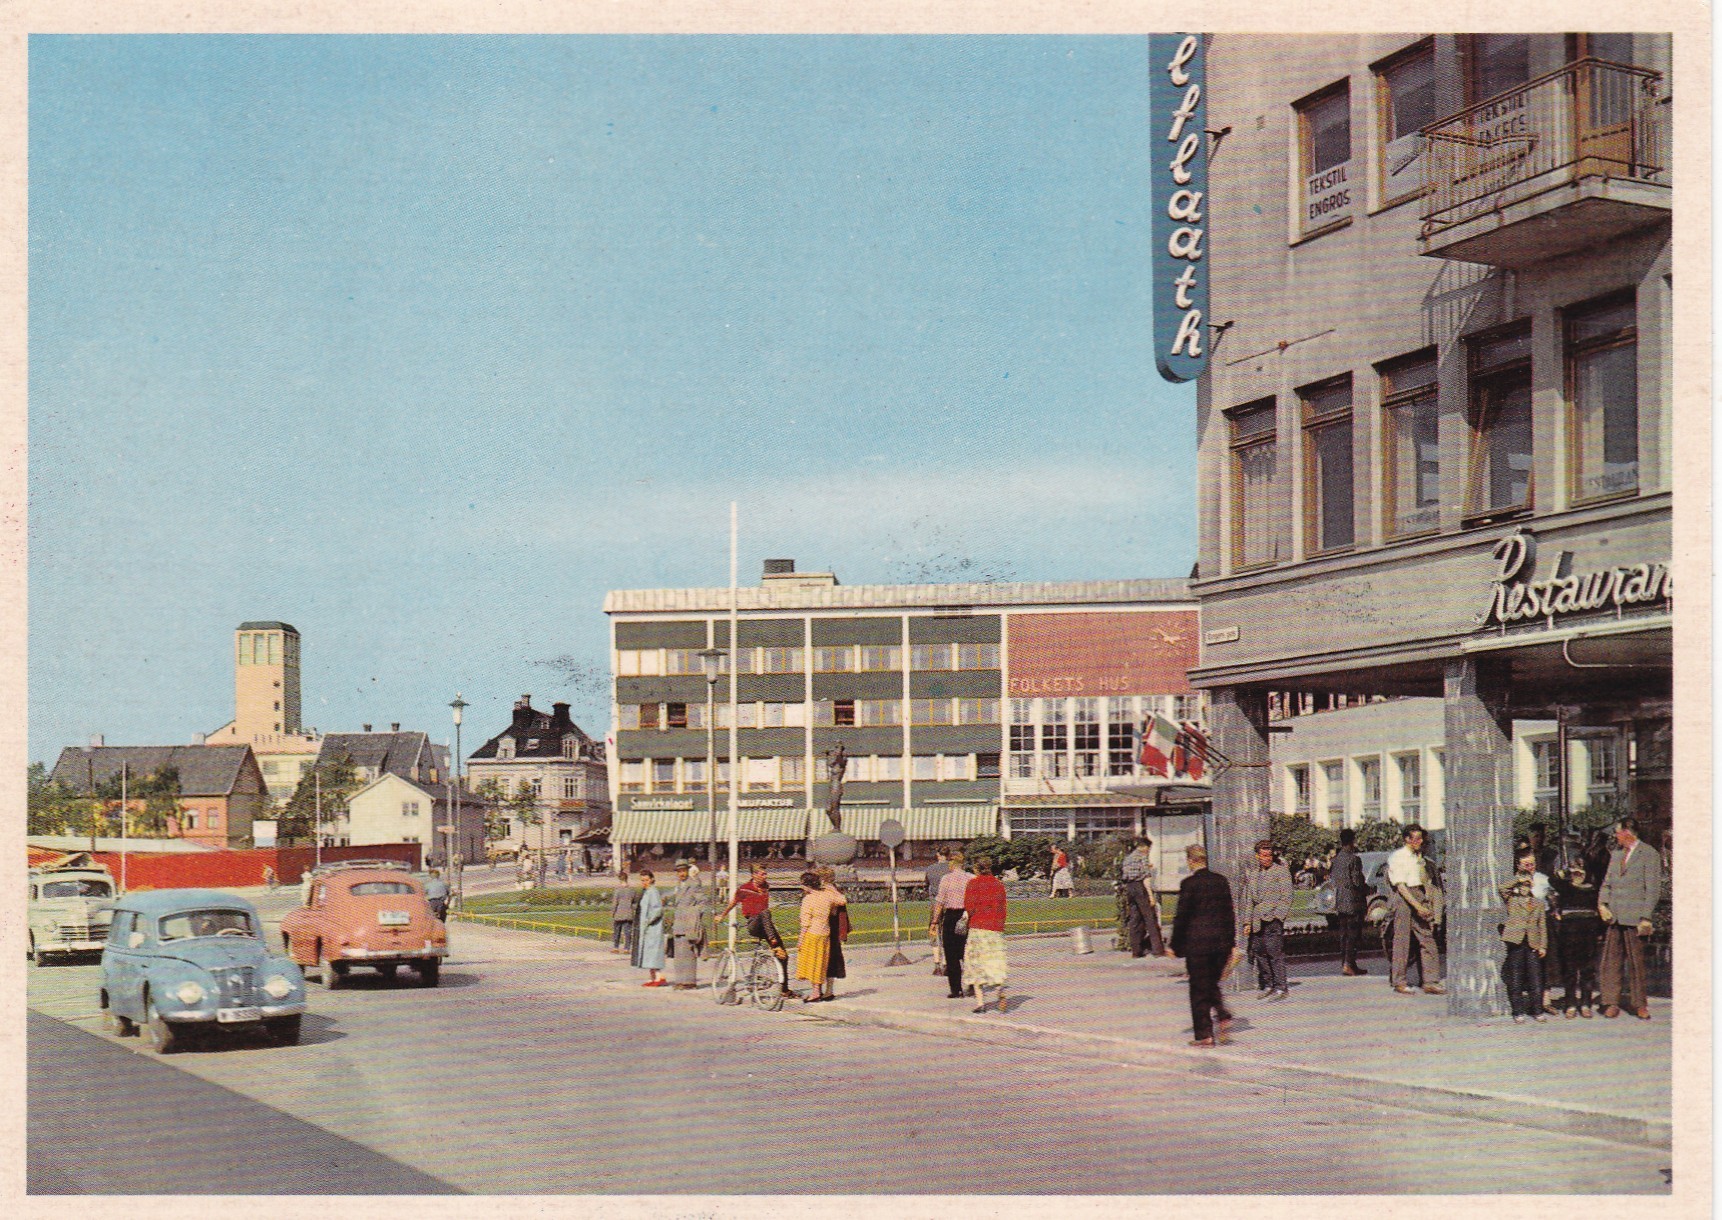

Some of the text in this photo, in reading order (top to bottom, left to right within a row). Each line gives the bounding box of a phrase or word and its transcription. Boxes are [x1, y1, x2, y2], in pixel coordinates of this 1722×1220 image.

[1309, 166, 1347, 195] TEKSTIL
[1309, 189, 1351, 219] ENGROS
[1009, 676, 1129, 692] FOLKETS HUS
